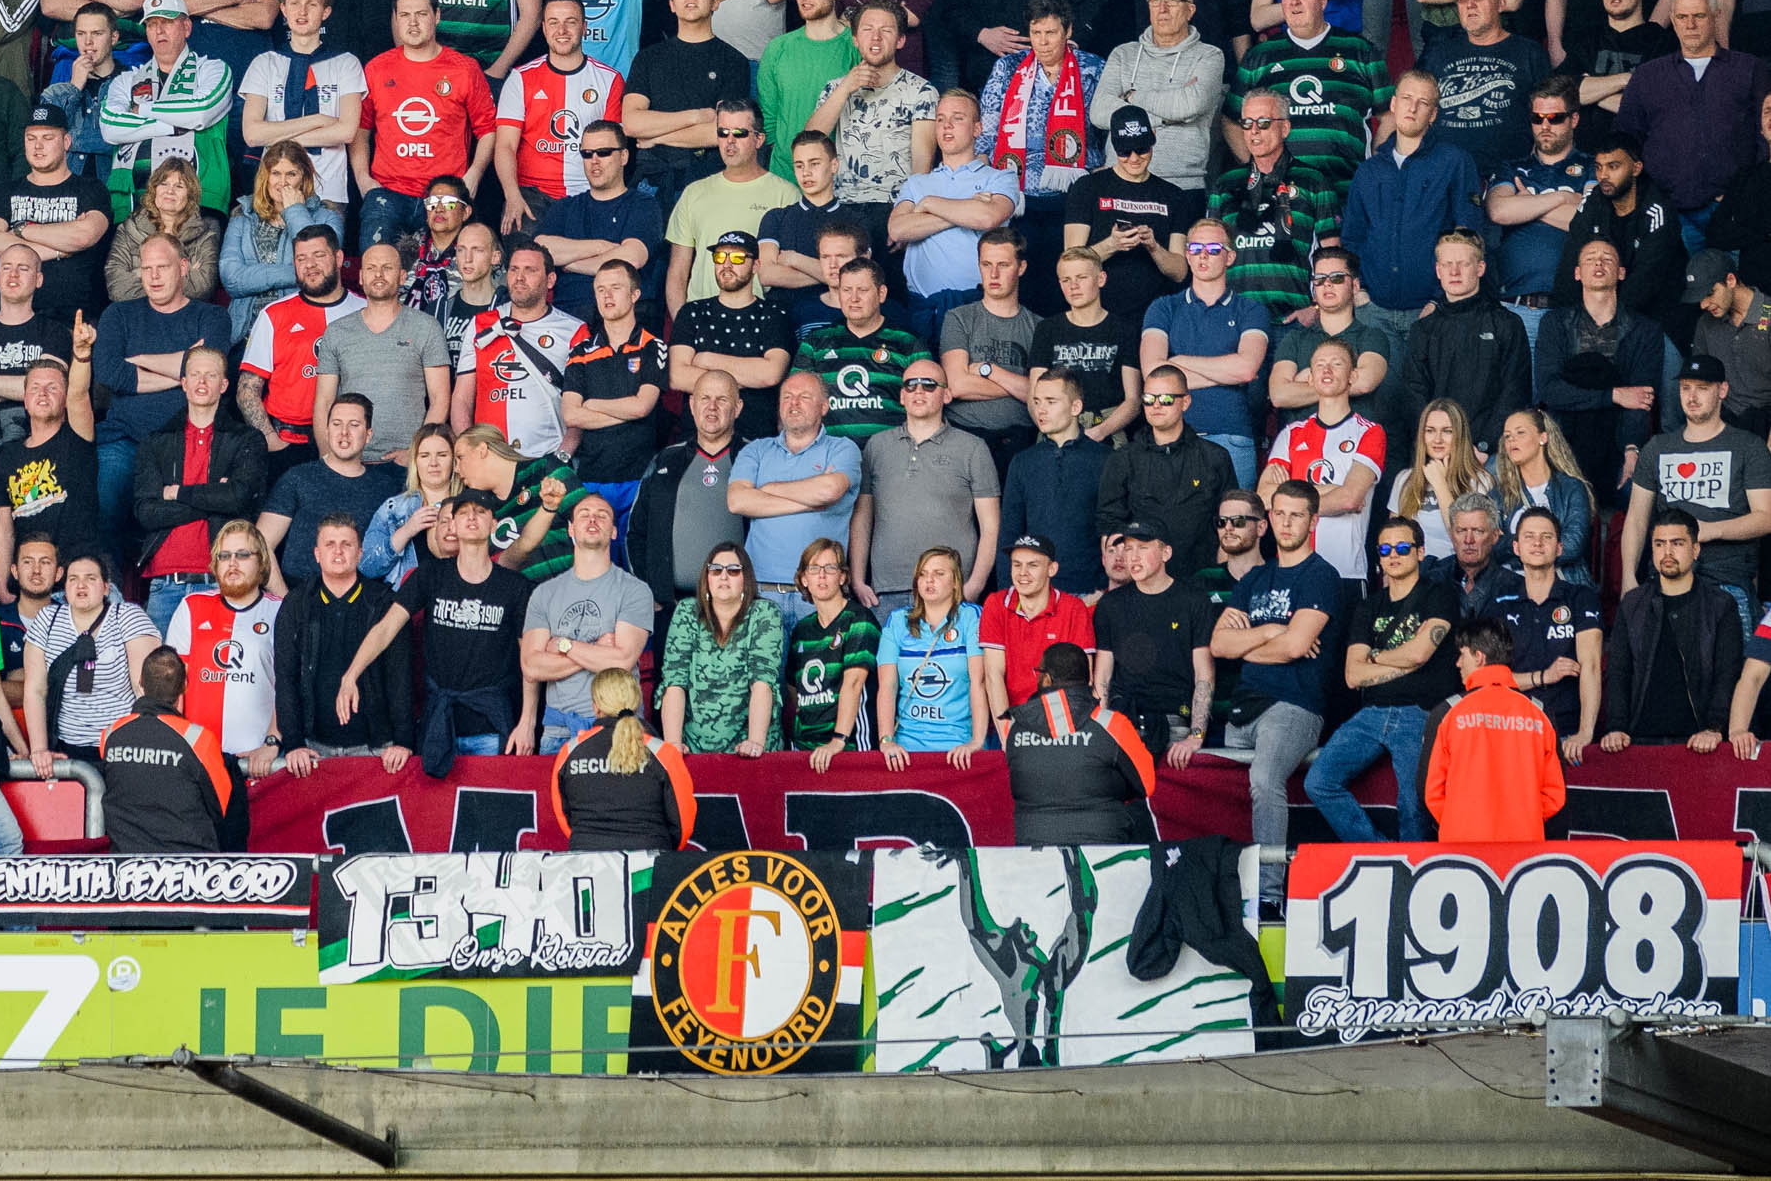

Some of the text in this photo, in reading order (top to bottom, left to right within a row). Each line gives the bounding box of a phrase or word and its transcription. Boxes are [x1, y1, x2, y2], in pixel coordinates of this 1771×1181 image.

[583, 28, 608, 42] PEL
[1288, 101, 1337, 116] urrent
[396, 143, 434, 158] OPEL
[536, 139, 582, 154] Qurre
[1235, 234, 1276, 250] Qurre
[974, 345, 1012, 355] NORTH
[991, 338, 1012, 346] THE
[24, 344, 43, 363] 190
[984, 355, 1013, 365] FACE
[489, 387, 527, 401] OPEL
[828, 395, 884, 411] Qurrent
[1665, 461, 1724, 479] I DE
[1666, 479, 1722, 501] KUIP
[480, 604, 504, 626] 1908
[1547, 624, 1574, 640] ASR
[199, 668, 255, 684] Qurrent
[910, 703, 946, 720] OPEL
[1456, 714, 1544, 735] SUPERVISOR
[106, 746, 183, 767] SECURITY
[111, 856, 299, 903] FEYENOORD
[661, 855, 834, 945] ALLES VOOR
[332, 853, 634, 968] 1340
[1321, 856, 1712, 1003] 1908
[529, 931, 633, 972] Rotstad
[704, 908, 781, 1013] F
[1298, 985, 1507, 1044] Feyenoord
[661, 994, 826, 1070] FEYENOORD
